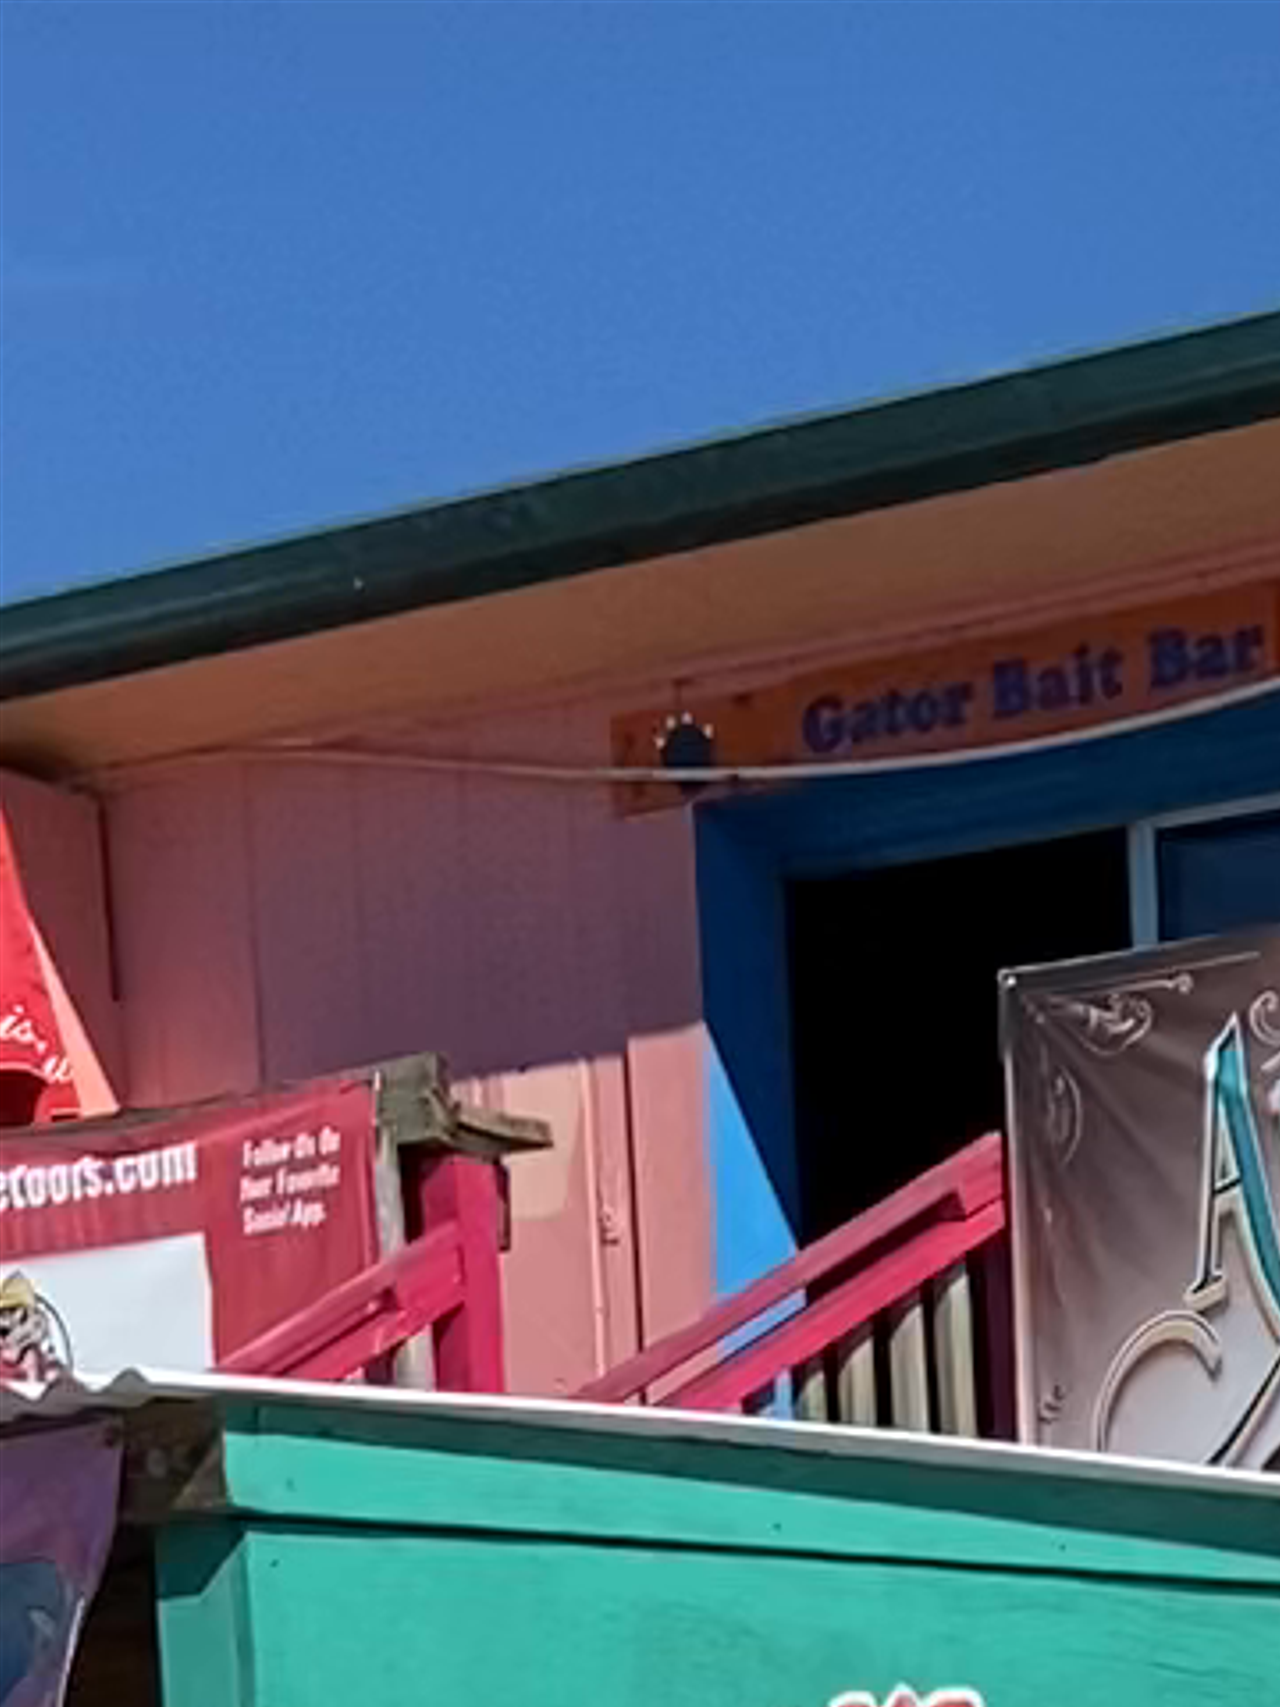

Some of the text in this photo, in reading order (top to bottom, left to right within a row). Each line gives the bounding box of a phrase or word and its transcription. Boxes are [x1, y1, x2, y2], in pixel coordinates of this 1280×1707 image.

[802, 624, 1265, 753] Gator Bait Bar
